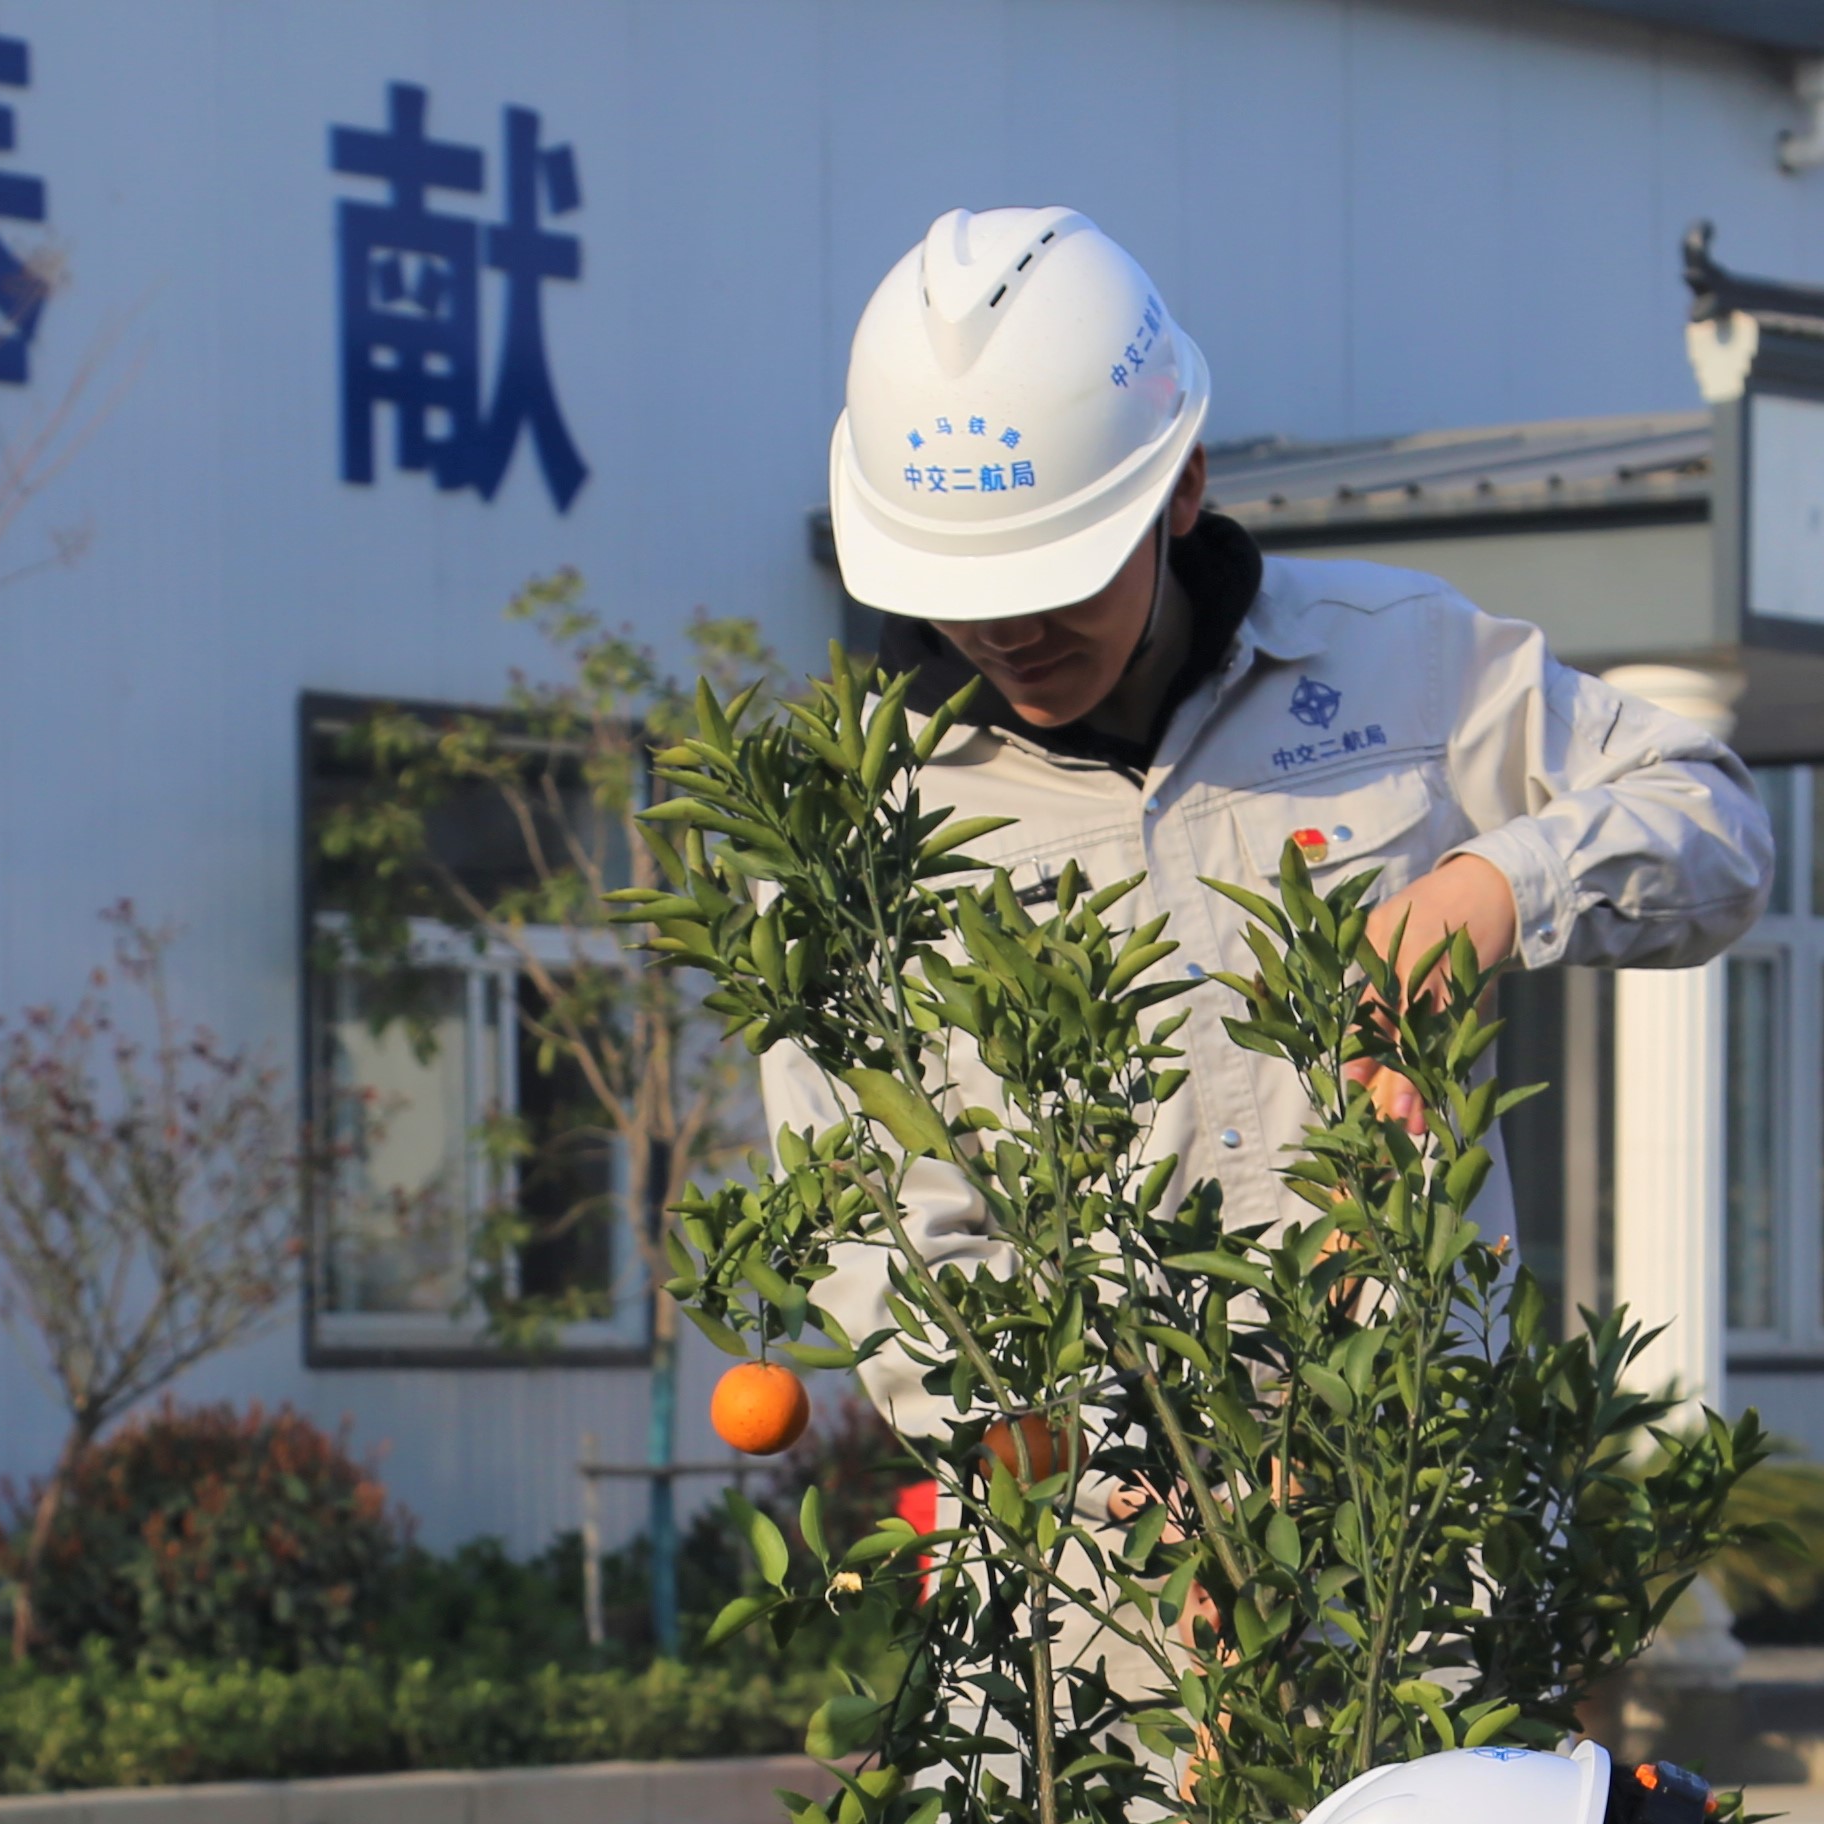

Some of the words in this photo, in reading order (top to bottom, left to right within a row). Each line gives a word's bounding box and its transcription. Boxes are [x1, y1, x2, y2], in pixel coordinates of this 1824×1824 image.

[903, 461, 1036, 494] 中交二航局
[1272, 723, 1388, 771] 中交二航局
